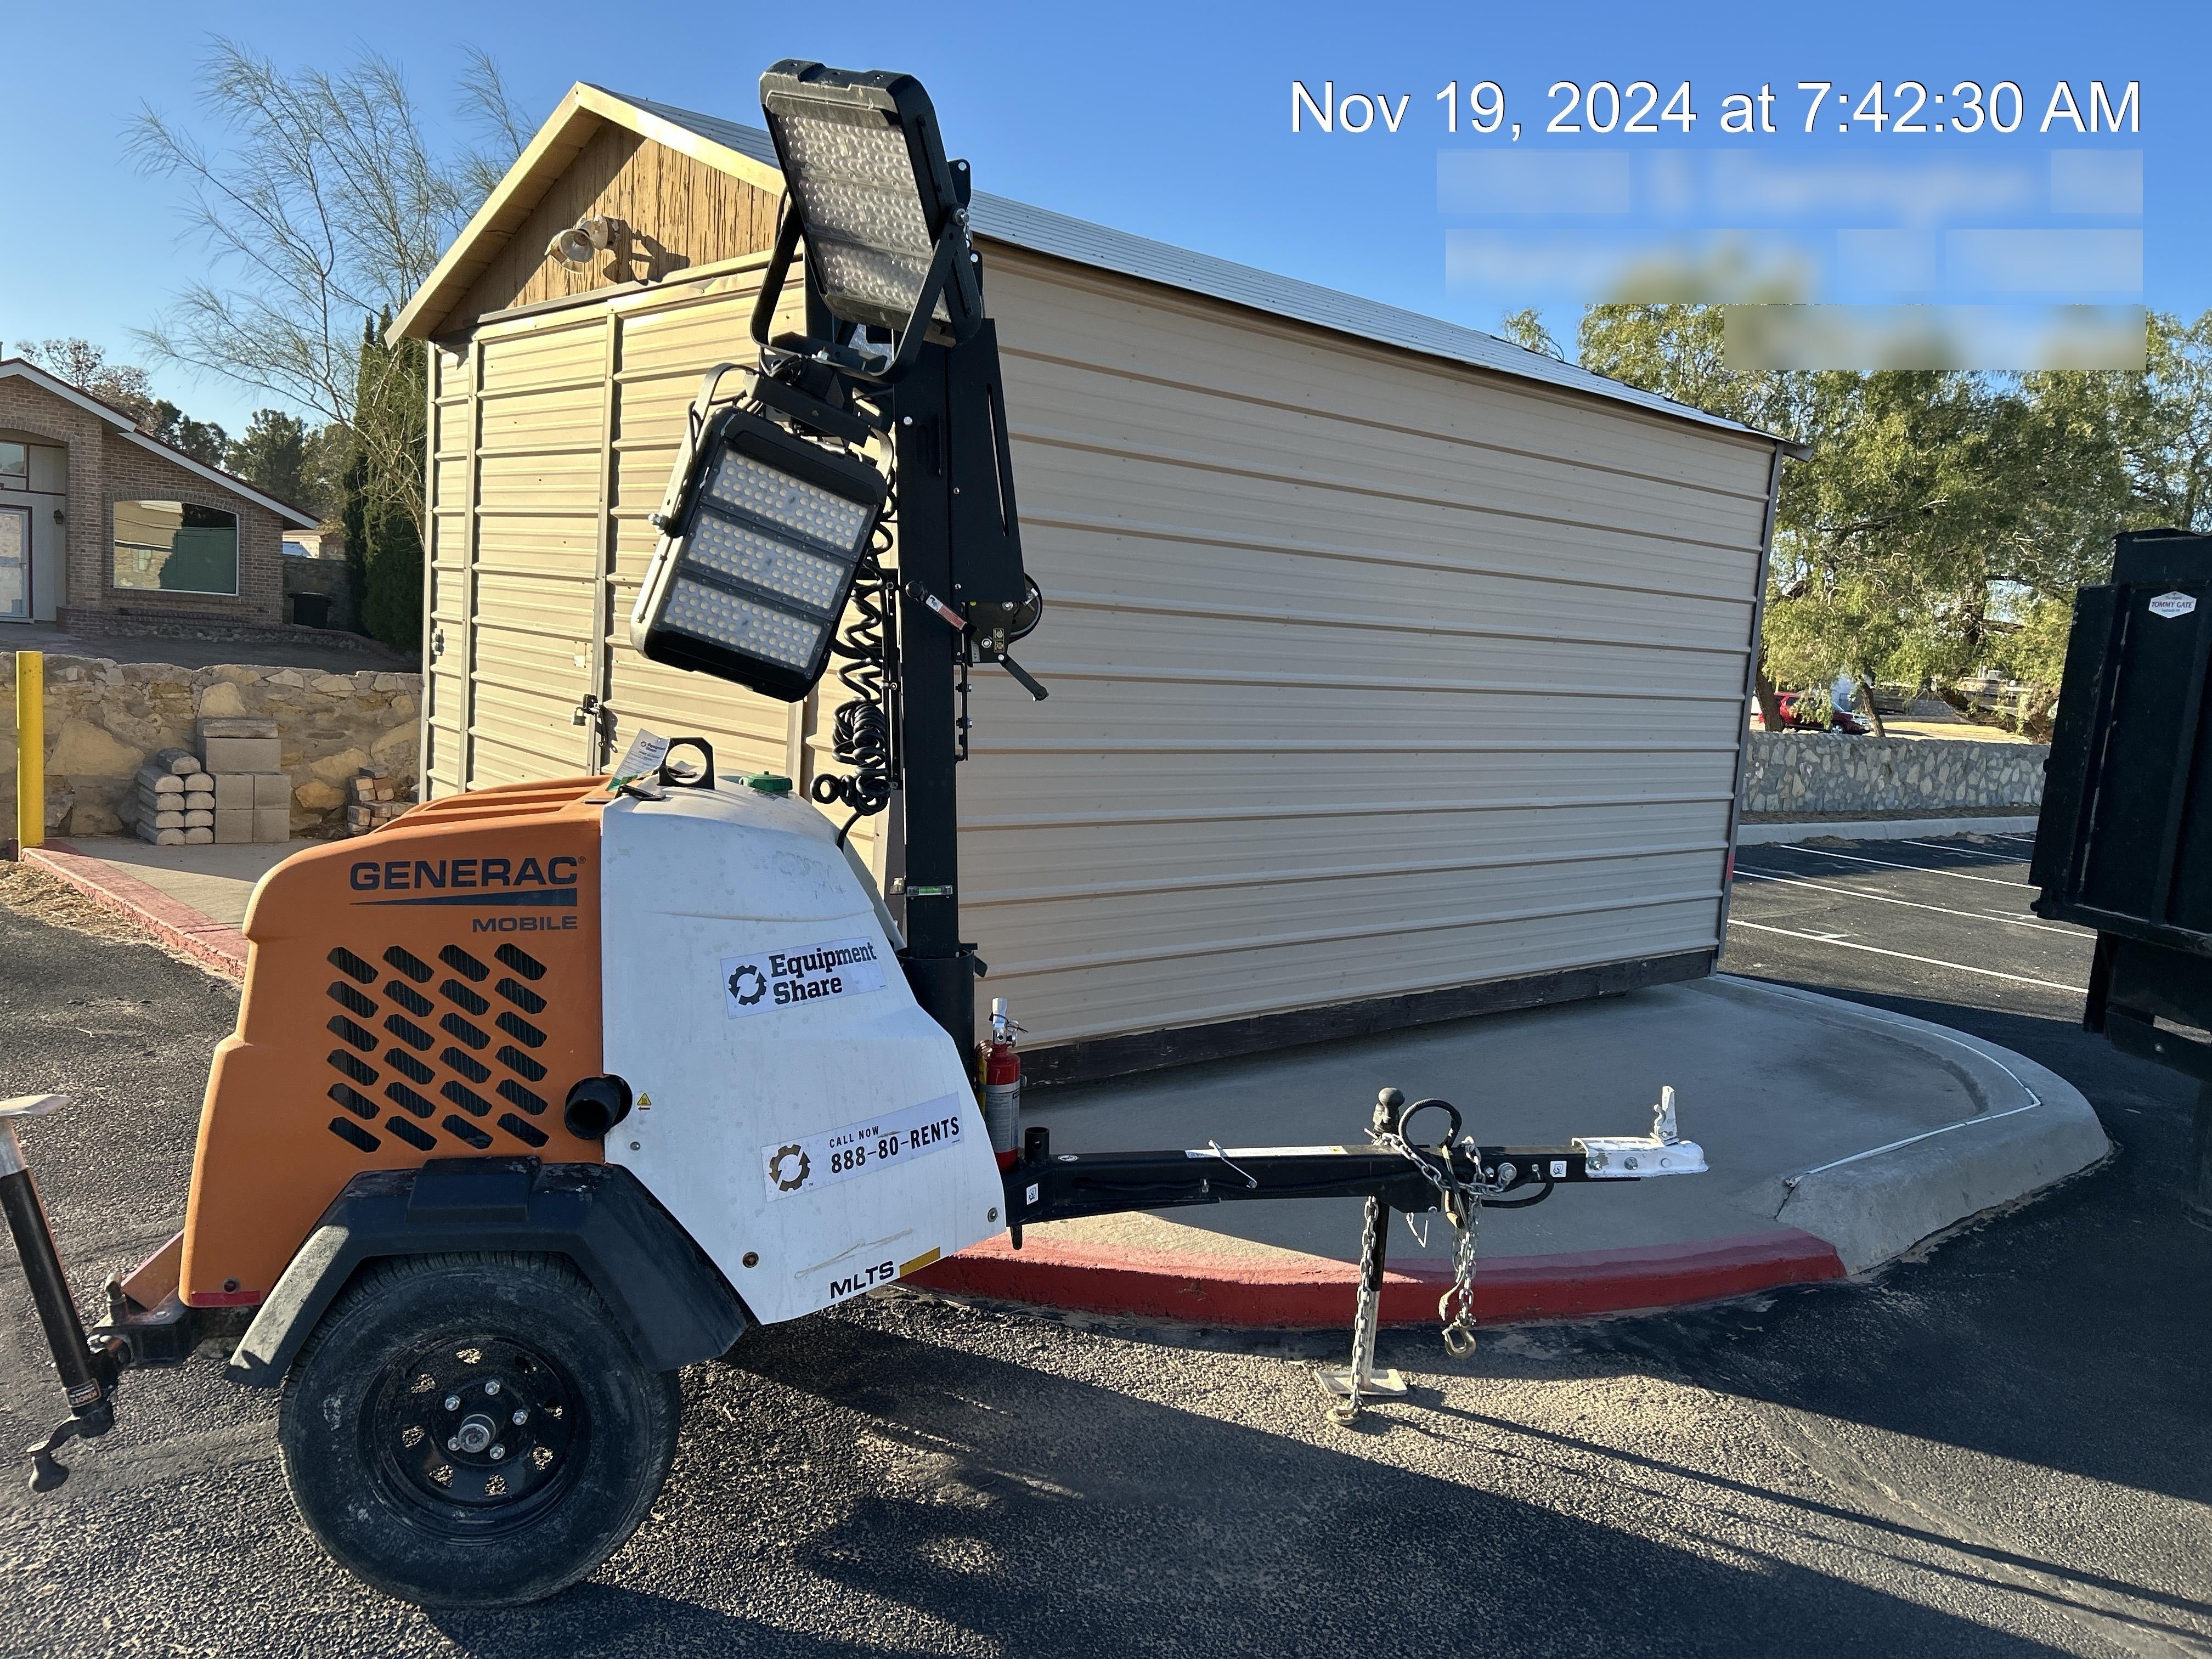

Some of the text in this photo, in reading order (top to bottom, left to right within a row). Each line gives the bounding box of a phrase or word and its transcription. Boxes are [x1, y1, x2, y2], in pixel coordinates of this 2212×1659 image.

[472, 916, 578, 933] MOBILE
[769, 941, 877, 979] Equipment
[772, 977, 843, 1005] Share
[829, 1125, 879, 1148] CALL NOW
[831, 1116, 960, 1173] 888-80-RENTS
[830, 1261, 894, 1299] MLTS
